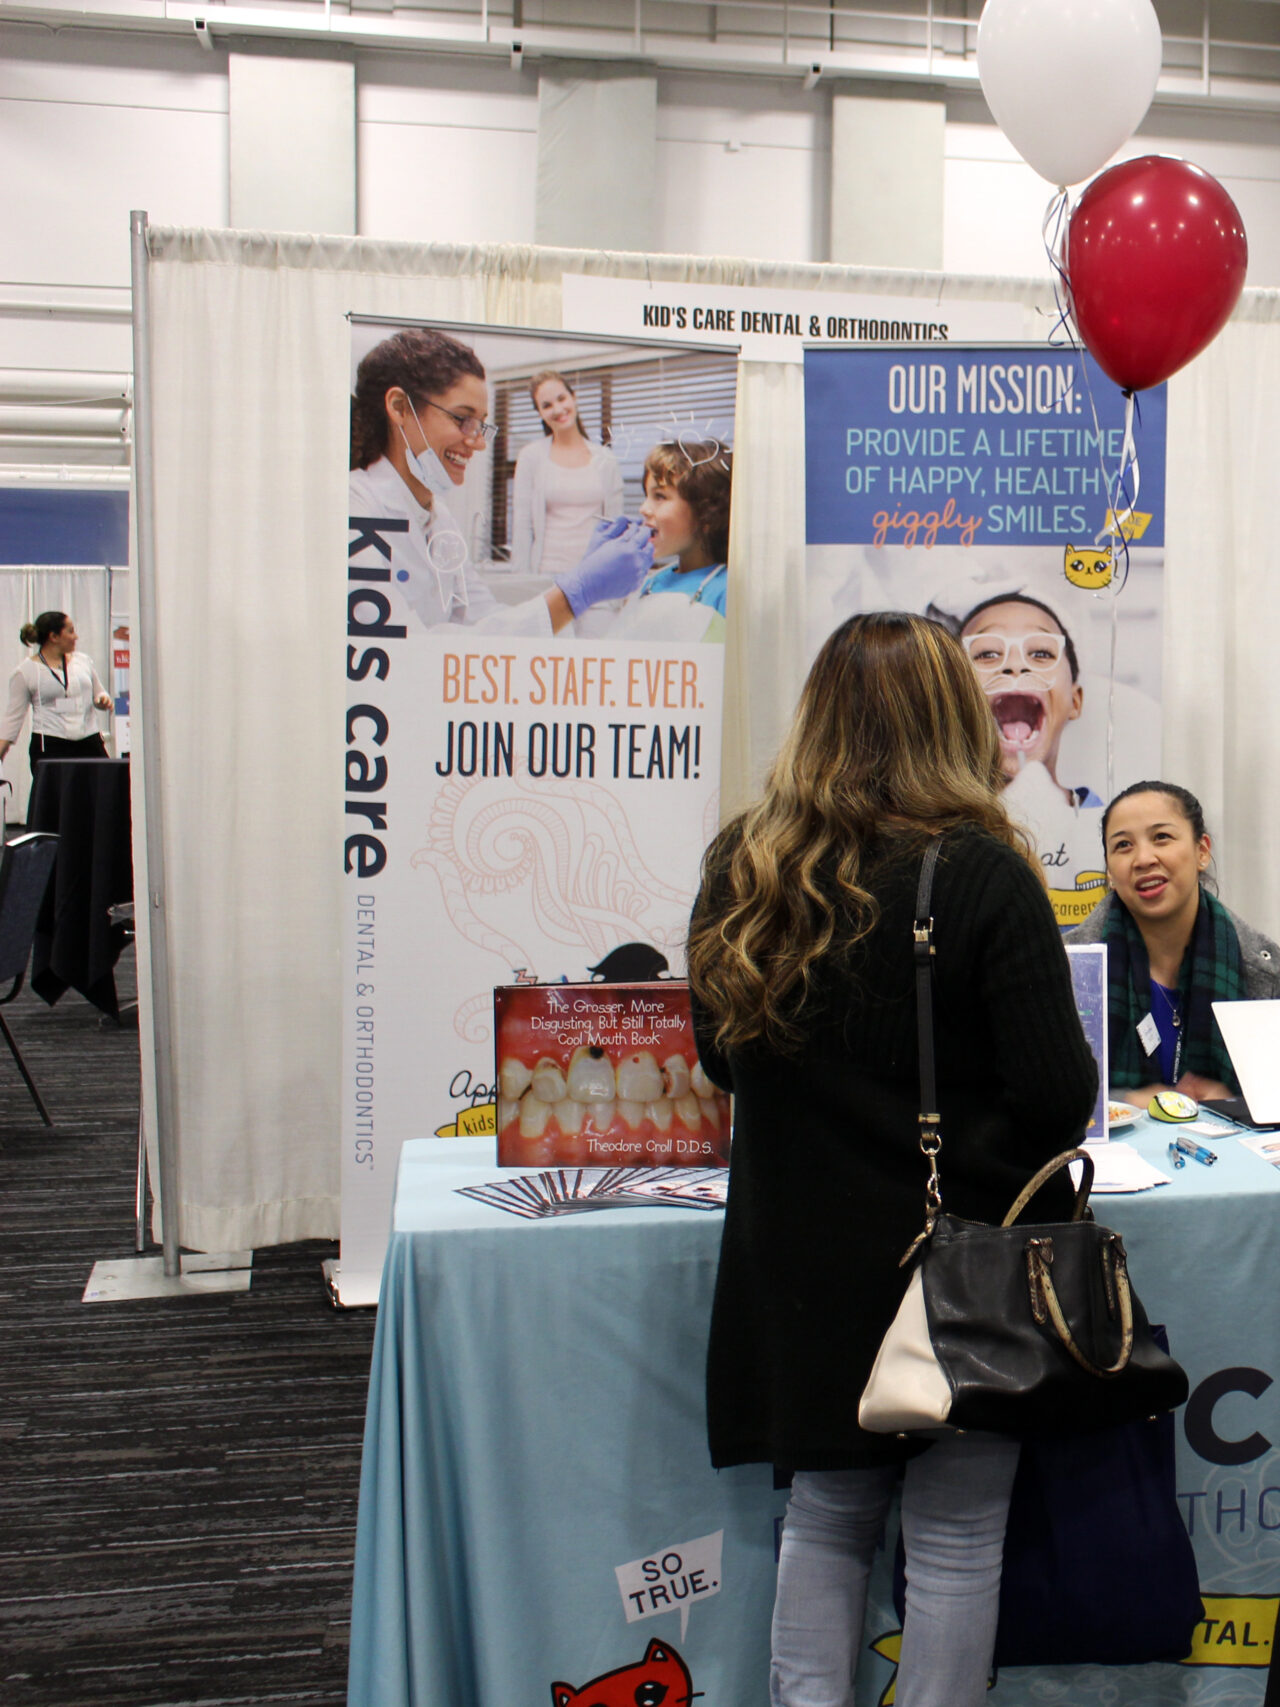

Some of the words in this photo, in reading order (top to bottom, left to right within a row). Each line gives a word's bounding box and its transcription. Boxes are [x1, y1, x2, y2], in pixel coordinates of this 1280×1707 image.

[643, 304, 687, 330] KID'S
[692, 308, 735, 332] CARE
[741, 311, 803, 336] DENTAL
[809, 316, 822, 337] &
[827, 317, 949, 341] ORTHODONTICS
[889, 364, 947, 414] OUR
[957, 365, 1083, 415] MISSION:
[846, 428, 966, 457] PROVIDE
[973, 429, 991, 456] A
[1000, 429, 1124, 458] LIFETIME
[845, 466, 881, 494] OF
[889, 466, 986, 497] HAPPY,
[995, 467, 1124, 498] HEALTHY,
[872, 498, 983, 550] giggly
[988, 505, 1092, 534] SMILES.
[347, 516, 409, 682] kids
[442, 653, 519, 705] BEST.
[529, 655, 616, 707] STAFF.
[626, 658, 704, 709] EVER.
[435, 720, 514, 778] JOIN
[528, 721, 596, 779] OUR
[608, 723, 702, 780] TEAM!
[344, 703, 390, 878] care
[356, 895, 375, 975] DENTAL
[356, 983, 375, 997] &
[547, 1000, 569, 1014] The
[573, 1000, 626, 1016] Grosser,
[630, 1000, 665, 1014] More
[531, 1016, 593, 1035] Disgusting,
[598, 1016, 618, 1030] But
[622, 1015, 644, 1030] Still
[647, 1015, 686, 1032] Totally
[557, 1033, 583, 1046] Cool
[588, 1033, 627, 1046] Mouth
[631, 1033, 661, 1046] Book
[355, 1005, 375, 1165] ORTHODONTICS
[587, 1139, 642, 1154] Theodore
[646, 1140, 672, 1154] Croll
[676, 1140, 714, 1155] D.D.S.
[641, 1553, 683, 1582] SO
[628, 1569, 719, 1615] TRUE.
